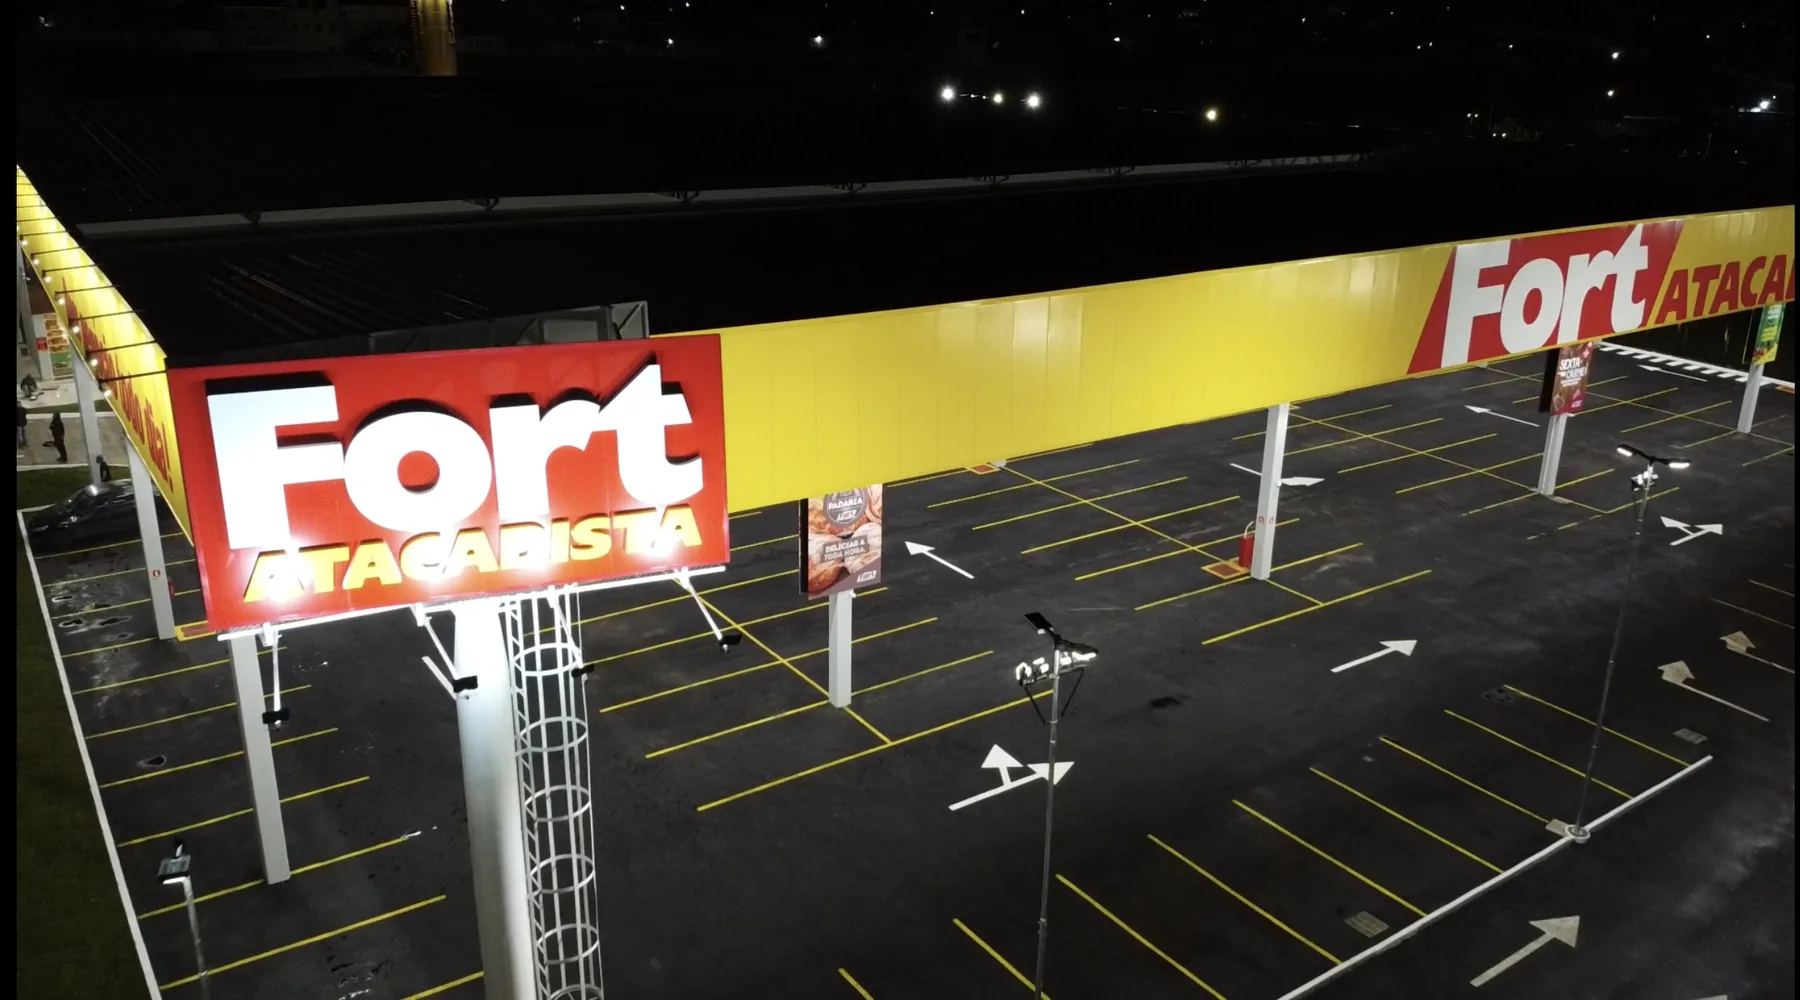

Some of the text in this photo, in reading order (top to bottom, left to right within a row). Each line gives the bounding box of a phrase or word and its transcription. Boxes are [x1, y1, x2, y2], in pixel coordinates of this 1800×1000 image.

[1441, 224, 1795, 369] Fort ATACA
[206, 358, 704, 551] Fort
[828, 498, 863, 510] PADARIA
[244, 504, 703, 603] ATACADISTA
[824, 552, 843, 560] TODA
